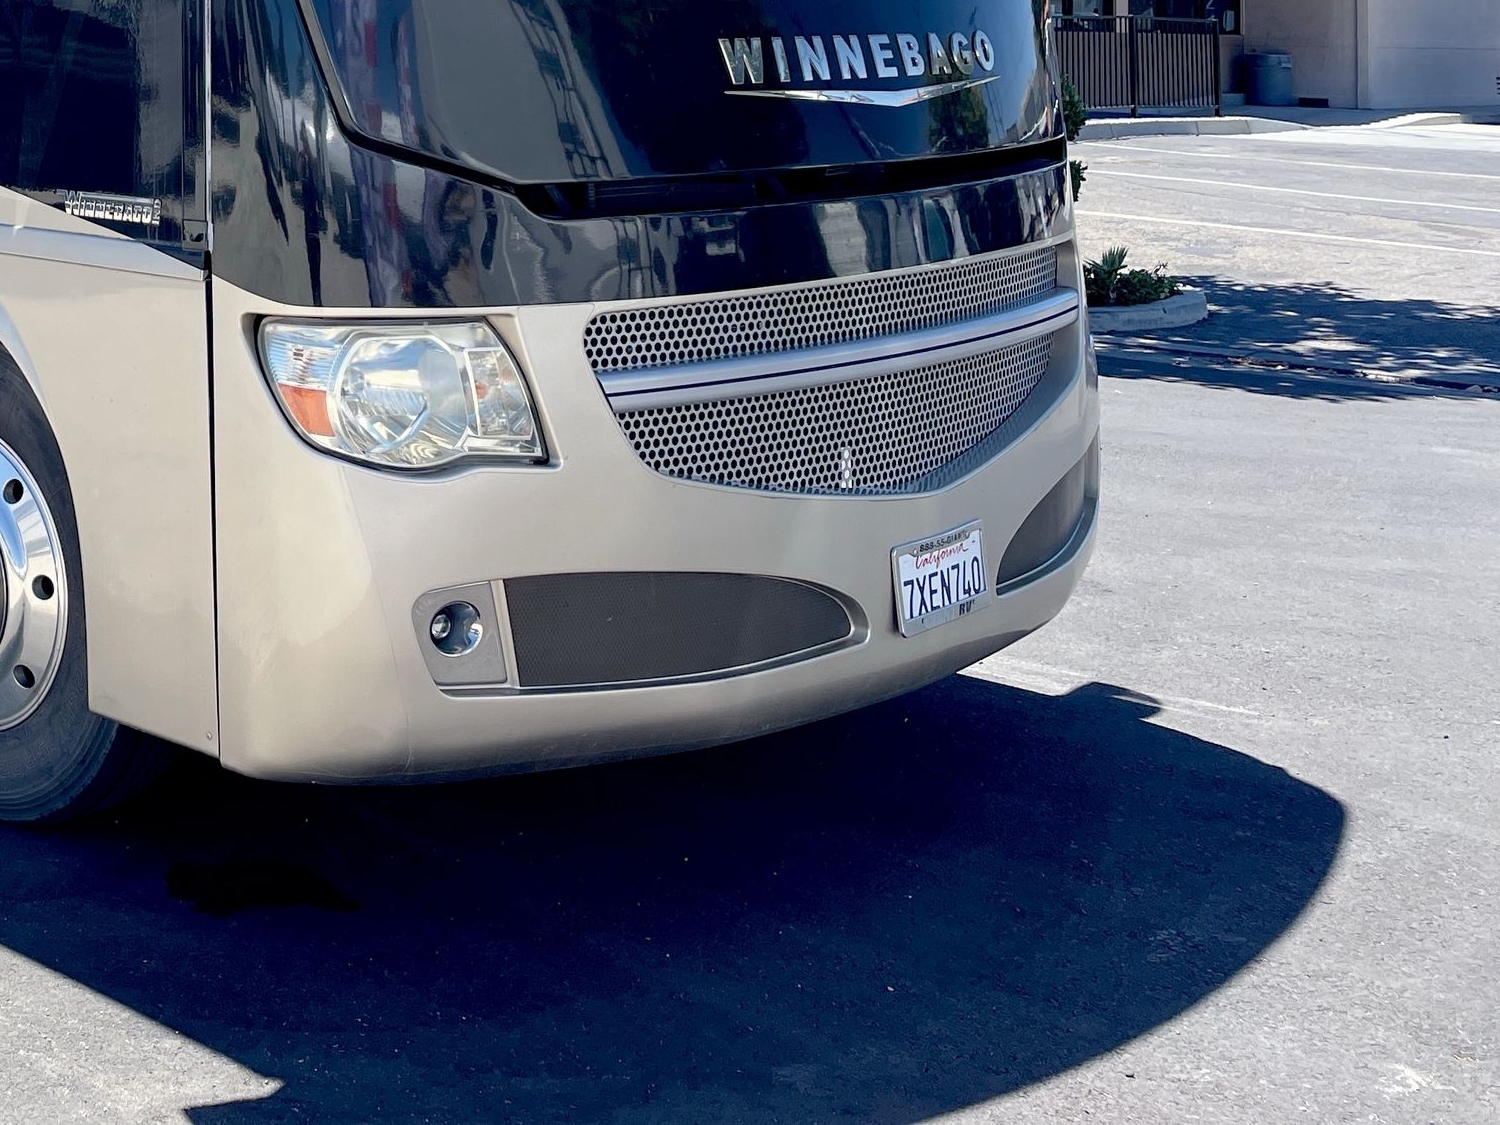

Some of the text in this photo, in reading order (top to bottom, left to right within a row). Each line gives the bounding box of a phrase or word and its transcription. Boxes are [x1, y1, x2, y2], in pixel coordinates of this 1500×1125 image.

[717, 29, 996, 85] WINNEBAGO
[57, 189, 153, 224] WINNEBAGO
[915, 543, 969, 570] California
[903, 556, 981, 619] 7XEN740
